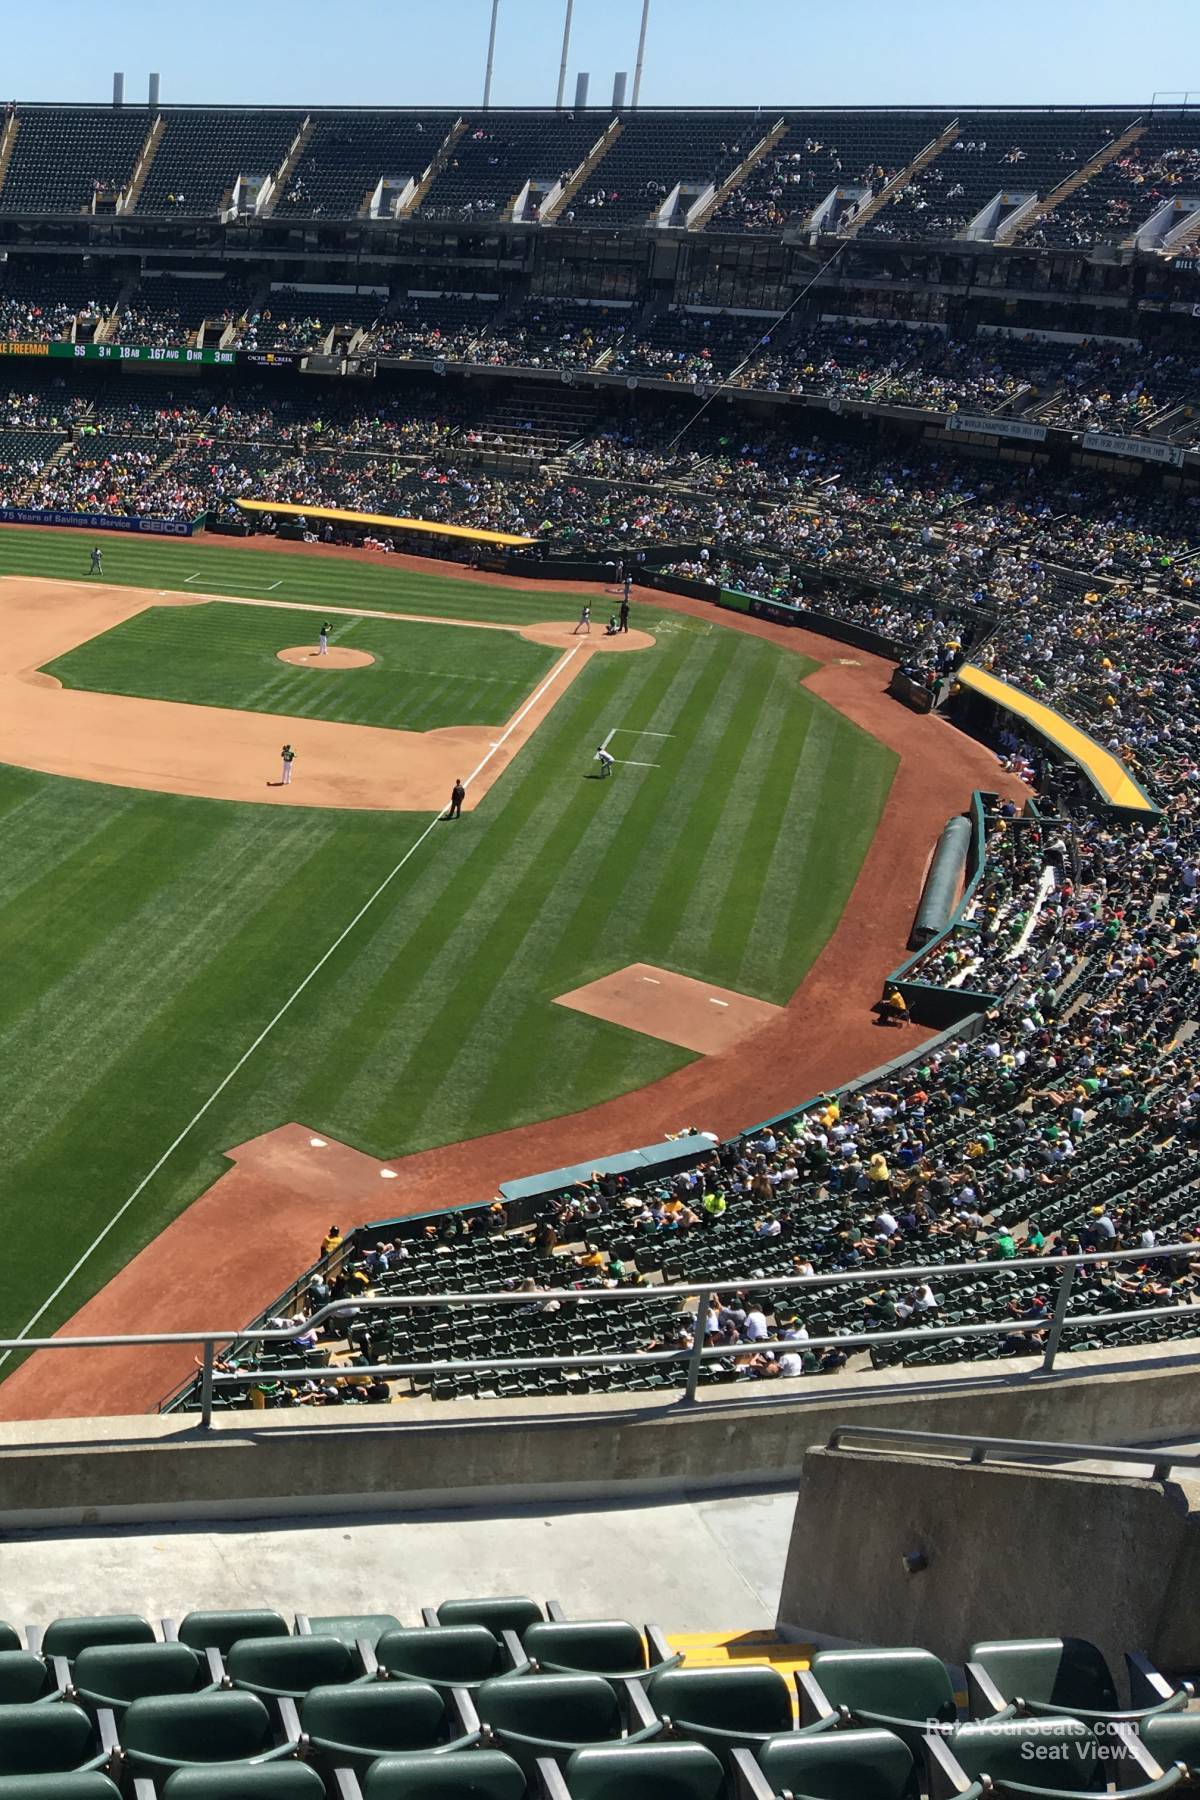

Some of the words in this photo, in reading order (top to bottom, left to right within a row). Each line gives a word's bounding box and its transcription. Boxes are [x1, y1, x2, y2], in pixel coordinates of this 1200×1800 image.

[9, 343, 49, 355] FREEMAN
[74, 345, 85, 356] SS
[99, 346, 104, 357] 3
[106, 347, 111, 356] H
[119, 347, 130, 358] 18
[131, 349, 140, 358] AB
[147, 349, 166, 359] .167
[166, 350, 179, 359] AVG
[186, 350, 193, 360] 0
[193, 351, 202, 360] HR
[215, 352, 220, 362] 3
[221, 353, 233, 362] RBI
[3, 511, 14, 519] 75
[17, 512, 40, 521] Years
[44, 513, 53, 522] of
[55, 515, 88, 526] Savings
[90, 517, 98, 525] &
[100, 518, 131, 528] Service
[139, 520, 187, 534] GEICO
